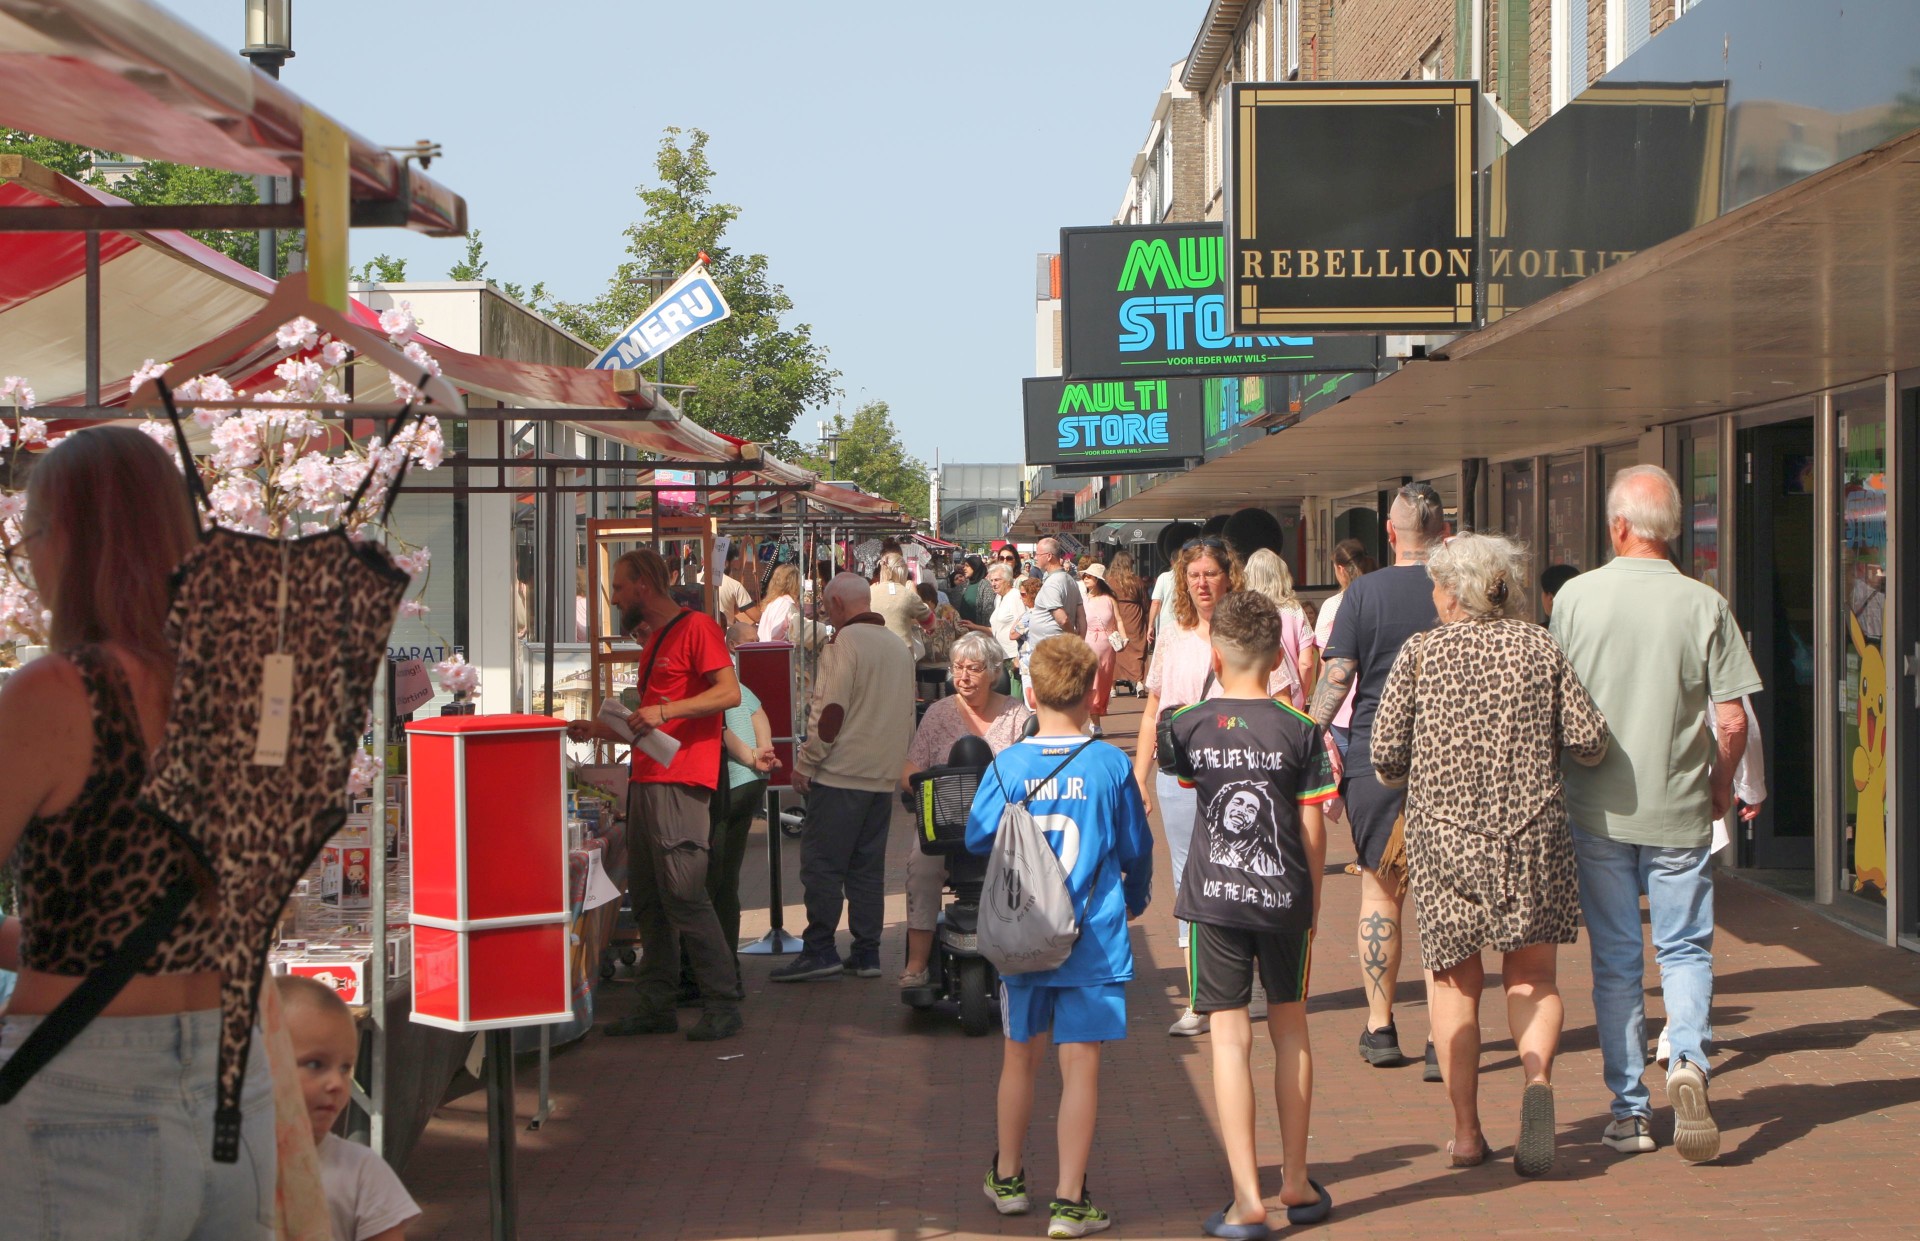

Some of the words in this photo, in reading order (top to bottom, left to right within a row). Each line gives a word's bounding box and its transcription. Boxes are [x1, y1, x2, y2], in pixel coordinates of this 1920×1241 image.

[1241, 249, 1472, 278] REBELLION
[1167, 357, 1194, 365] VOOR
[1196, 356, 1222, 364] IEDER
[1223, 355, 1243, 363] WAT
[1244, 354, 1266, 362] WILS
[1058, 380, 1167, 413] MULTI
[1058, 412, 1168, 448] STORE
[1204, 747, 1221, 770] THE
[1223, 748, 1243, 770] LIFE
[1244, 746, 1260, 770] YOU
[1262, 752, 1283, 770] LOVE
[1061, 777, 1087, 800] JR.
[1204, 878, 1222, 898] LOVE
[1224, 882, 1240, 901] THE
[1241, 884, 1259, 904] LIFE
[1260, 888, 1276, 908] YOU
